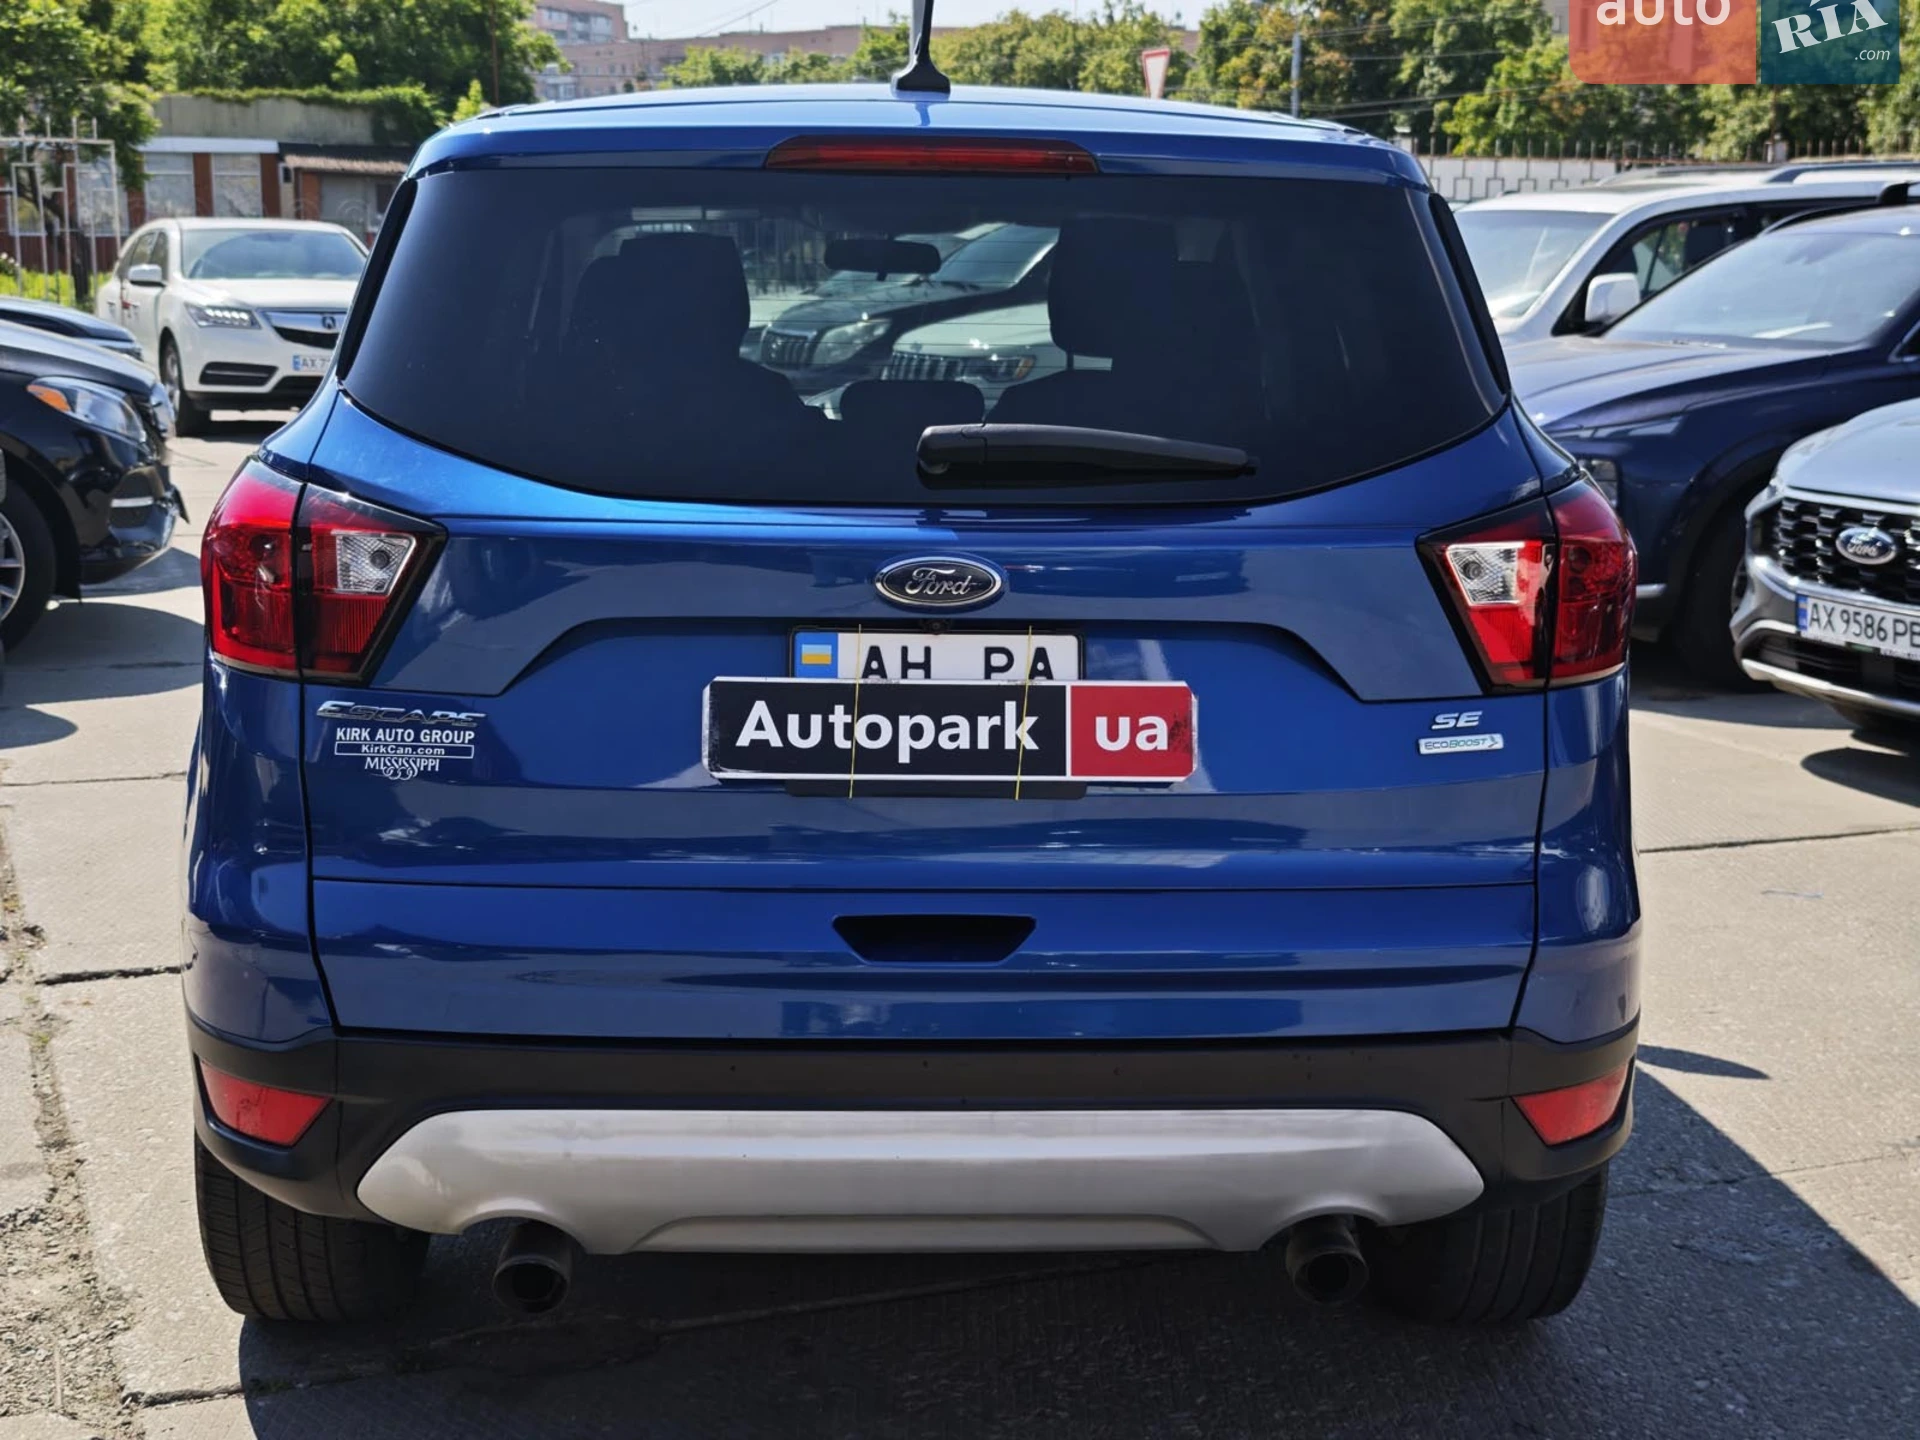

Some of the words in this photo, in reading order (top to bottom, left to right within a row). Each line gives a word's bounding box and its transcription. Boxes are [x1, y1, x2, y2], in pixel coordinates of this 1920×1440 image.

[905, 567, 974, 595] Ford
[1808, 603, 1836, 632] AX
[1840, 609, 1888, 642] 9586
[861, 645, 932, 680] AH
[983, 646, 1054, 681] PA
[316, 700, 487, 727] ESCAPE
[1431, 711, 1483, 730] SE
[336, 727, 371, 741] KIRK
[375, 728, 415, 742] AUTO
[420, 729, 475, 744] GROUP
[735, 700, 1040, 764] Autopark
[1094, 715, 1169, 751] ua
[361, 744, 445, 756] KirkCan.com
[364, 757, 440, 780] MISSISSIPPI
